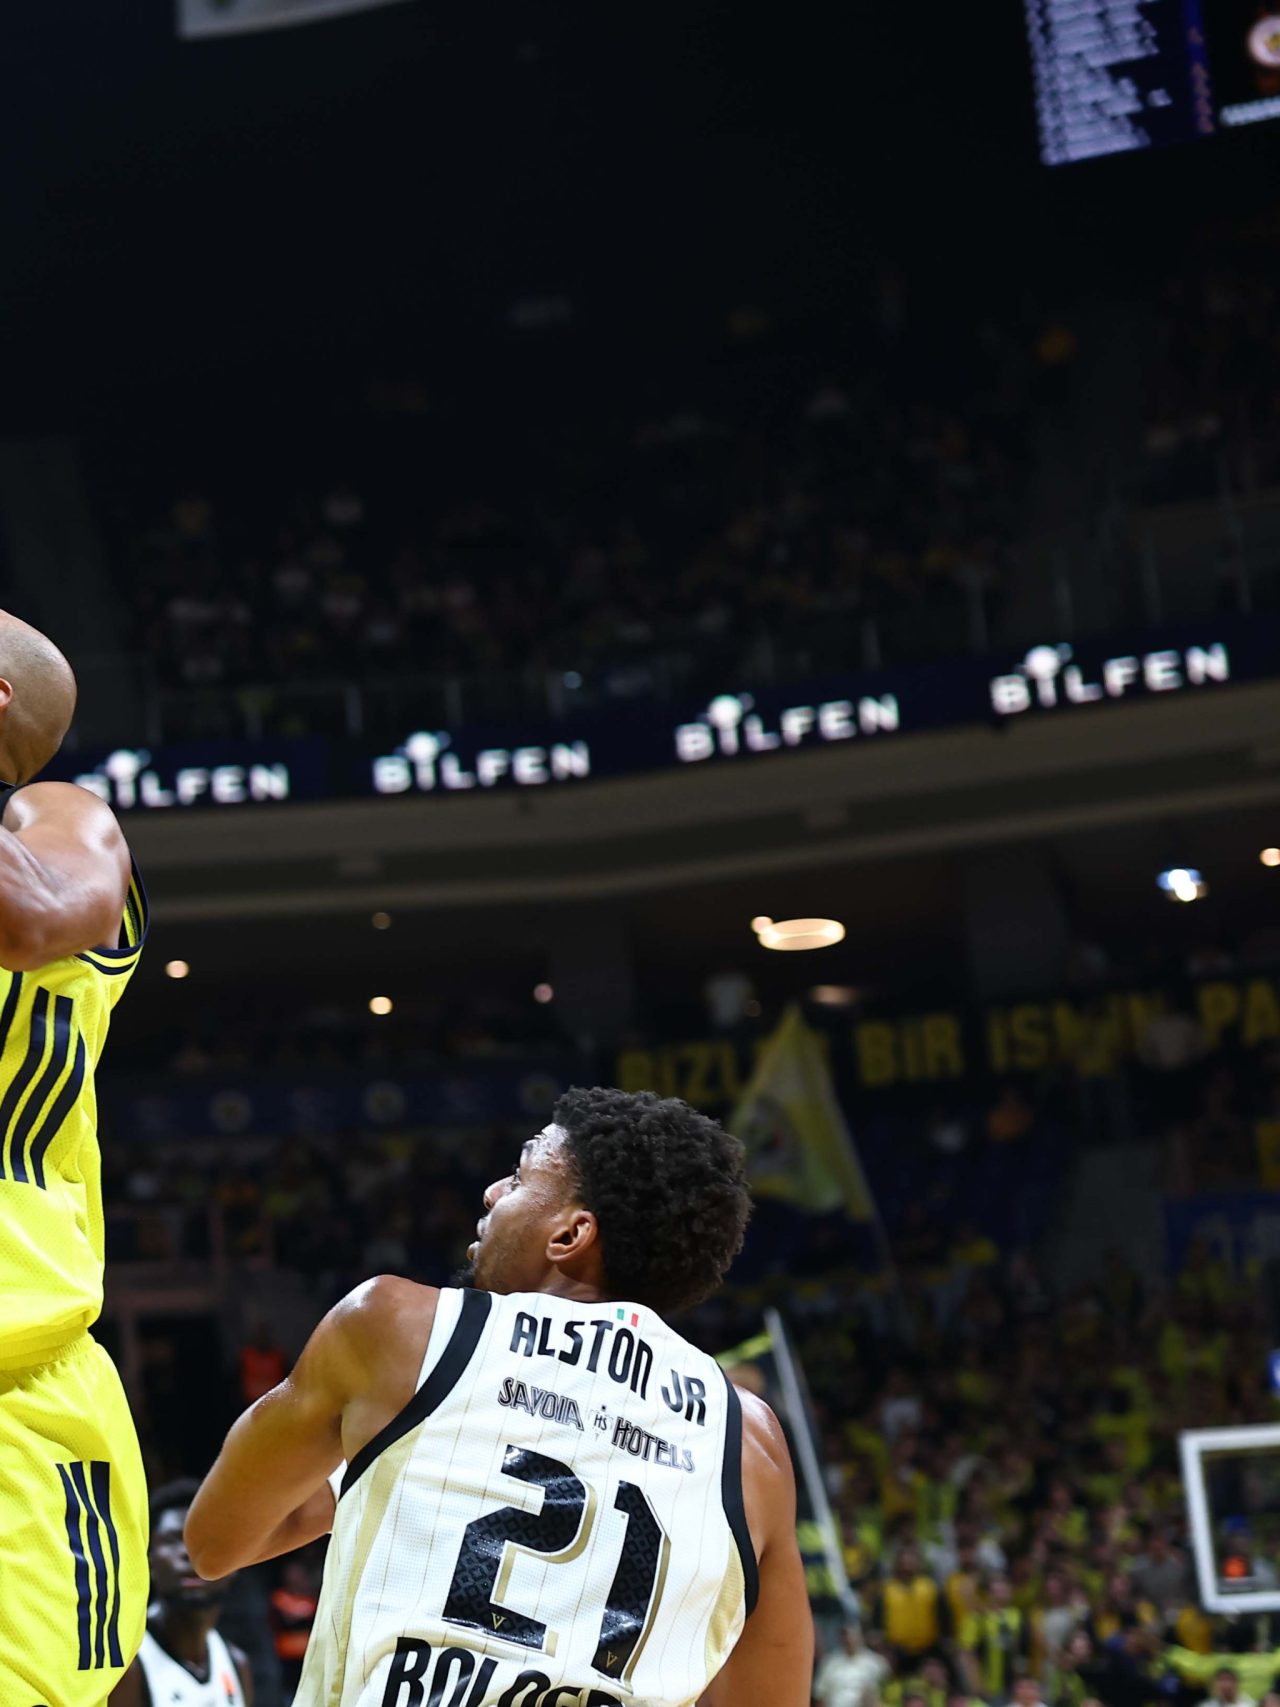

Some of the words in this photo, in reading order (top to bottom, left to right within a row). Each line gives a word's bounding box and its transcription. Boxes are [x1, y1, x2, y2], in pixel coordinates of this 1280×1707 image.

[498, 1376, 584, 1432] SAVOIA
[611, 1416, 696, 1473] HOTELS
[510, 1311, 653, 1400] ALSTON
[660, 1368, 706, 1427] JR
[441, 1444, 670, 1690] 21
